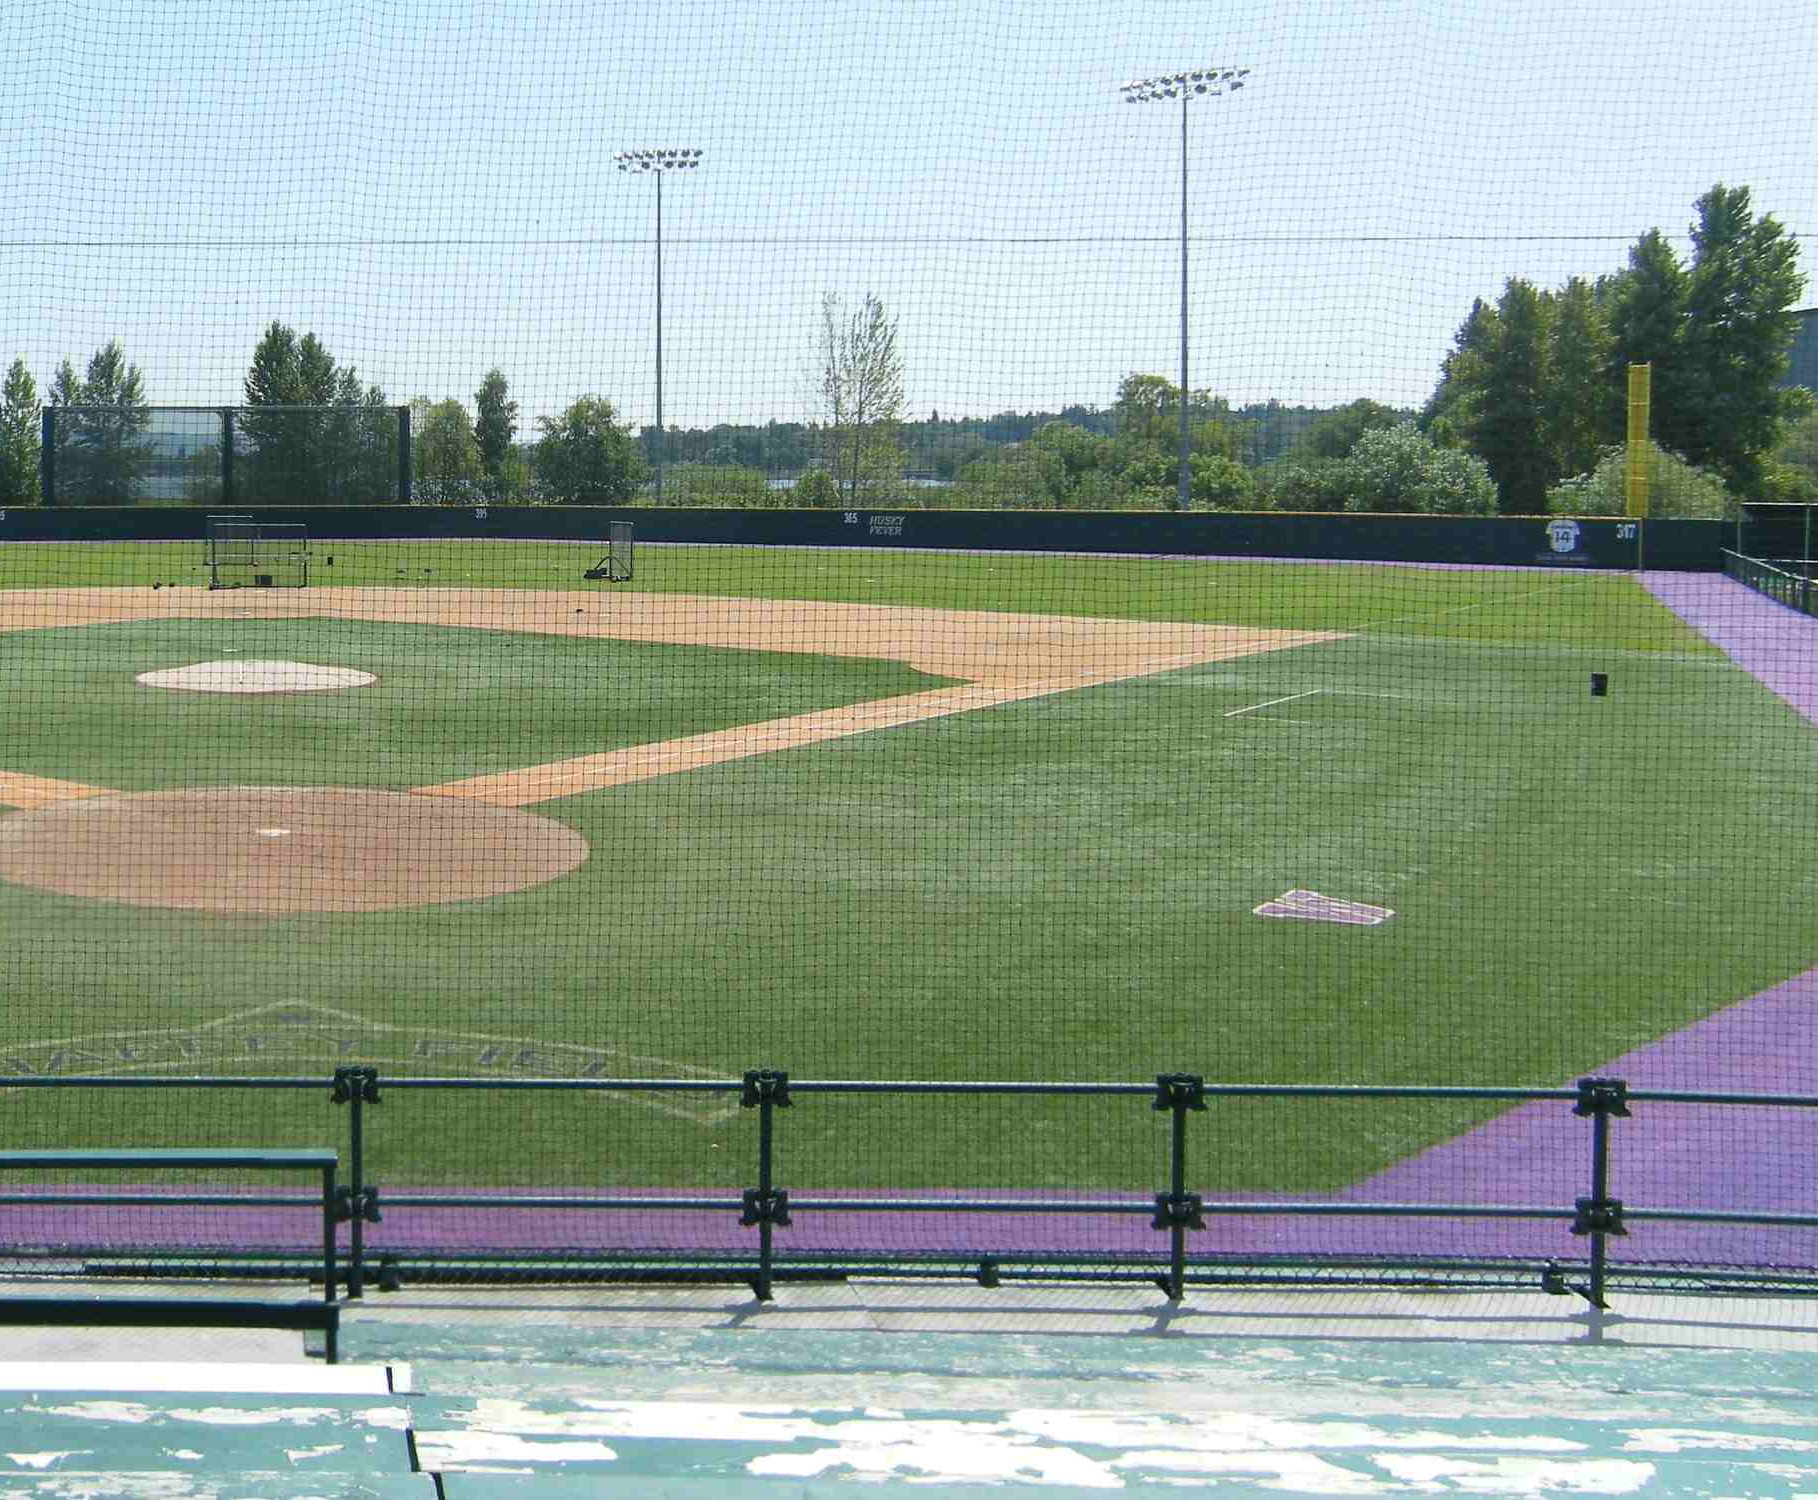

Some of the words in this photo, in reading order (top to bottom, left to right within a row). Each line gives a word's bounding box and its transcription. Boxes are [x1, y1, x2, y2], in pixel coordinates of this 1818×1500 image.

[869, 515, 905, 526] HUSKY
[1555, 531, 1570, 543] 14
[1615, 523, 1636, 539] 317
